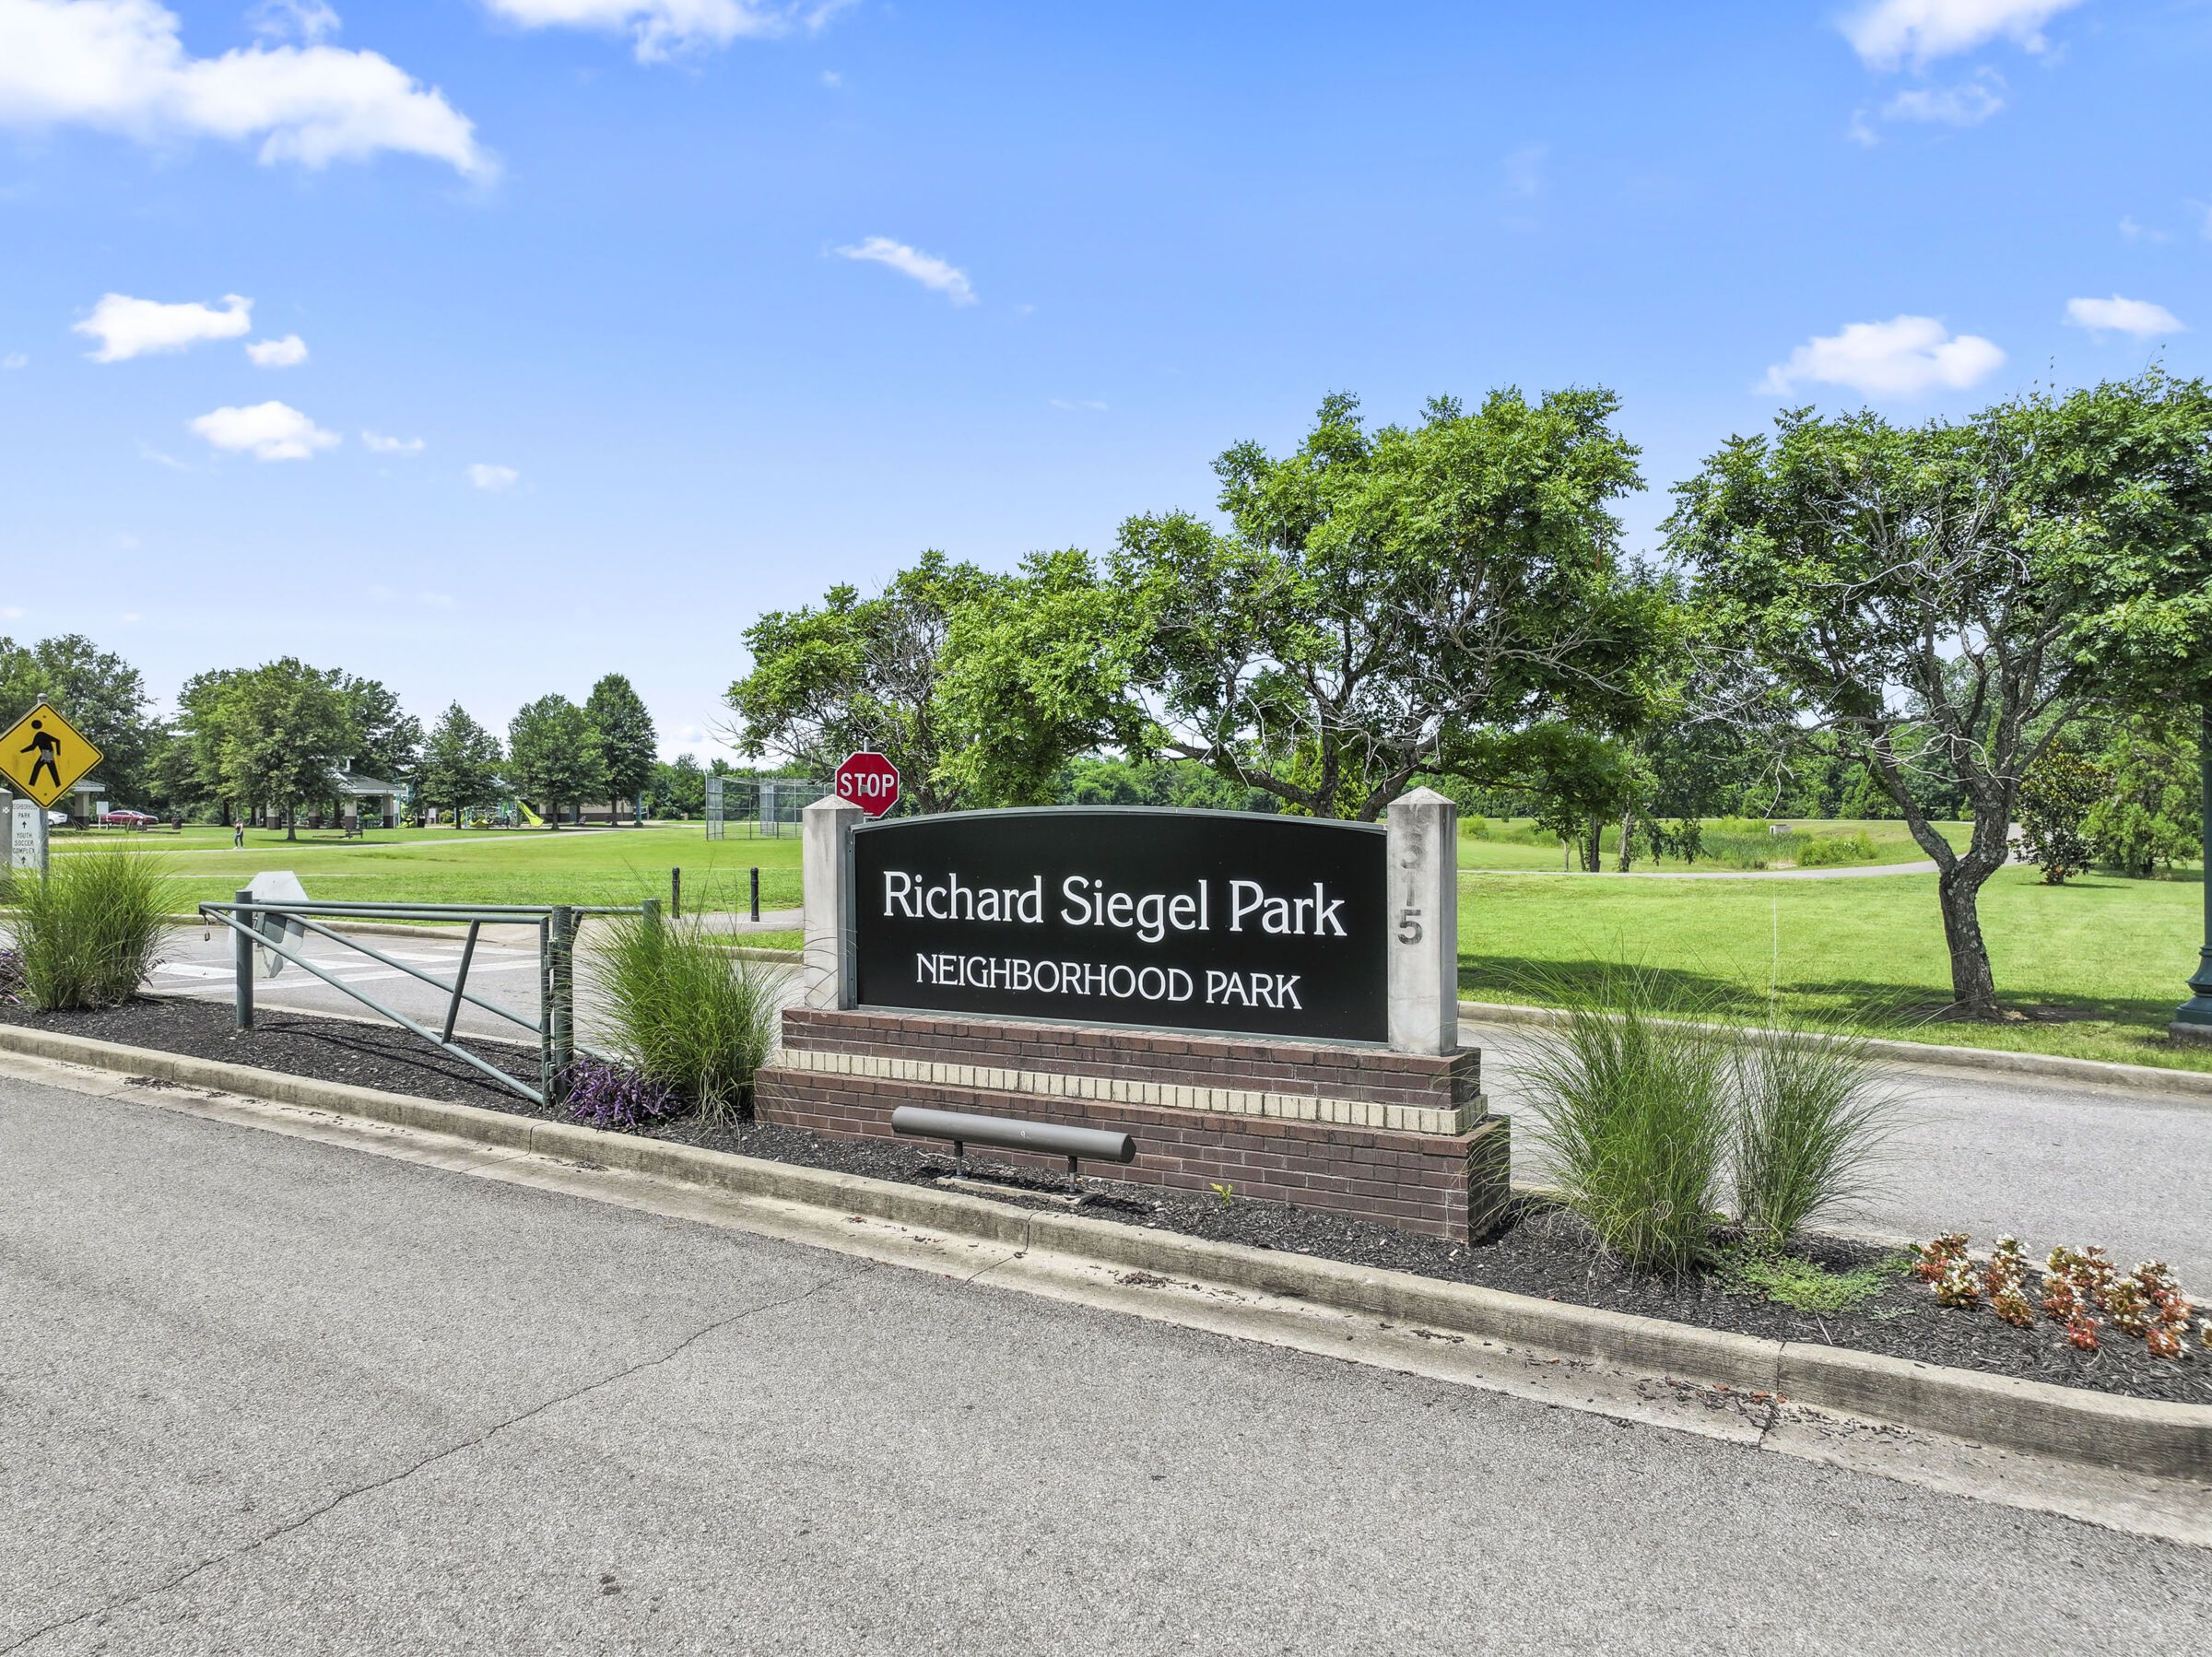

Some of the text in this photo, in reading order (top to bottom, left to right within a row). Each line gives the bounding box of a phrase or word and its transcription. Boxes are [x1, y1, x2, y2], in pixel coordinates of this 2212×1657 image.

[840, 772, 895, 797] STOP
[884, 871, 1347, 944] Richard Siegel Park
[916, 953, 1303, 1010] NEIGHBORHOOD PARK
